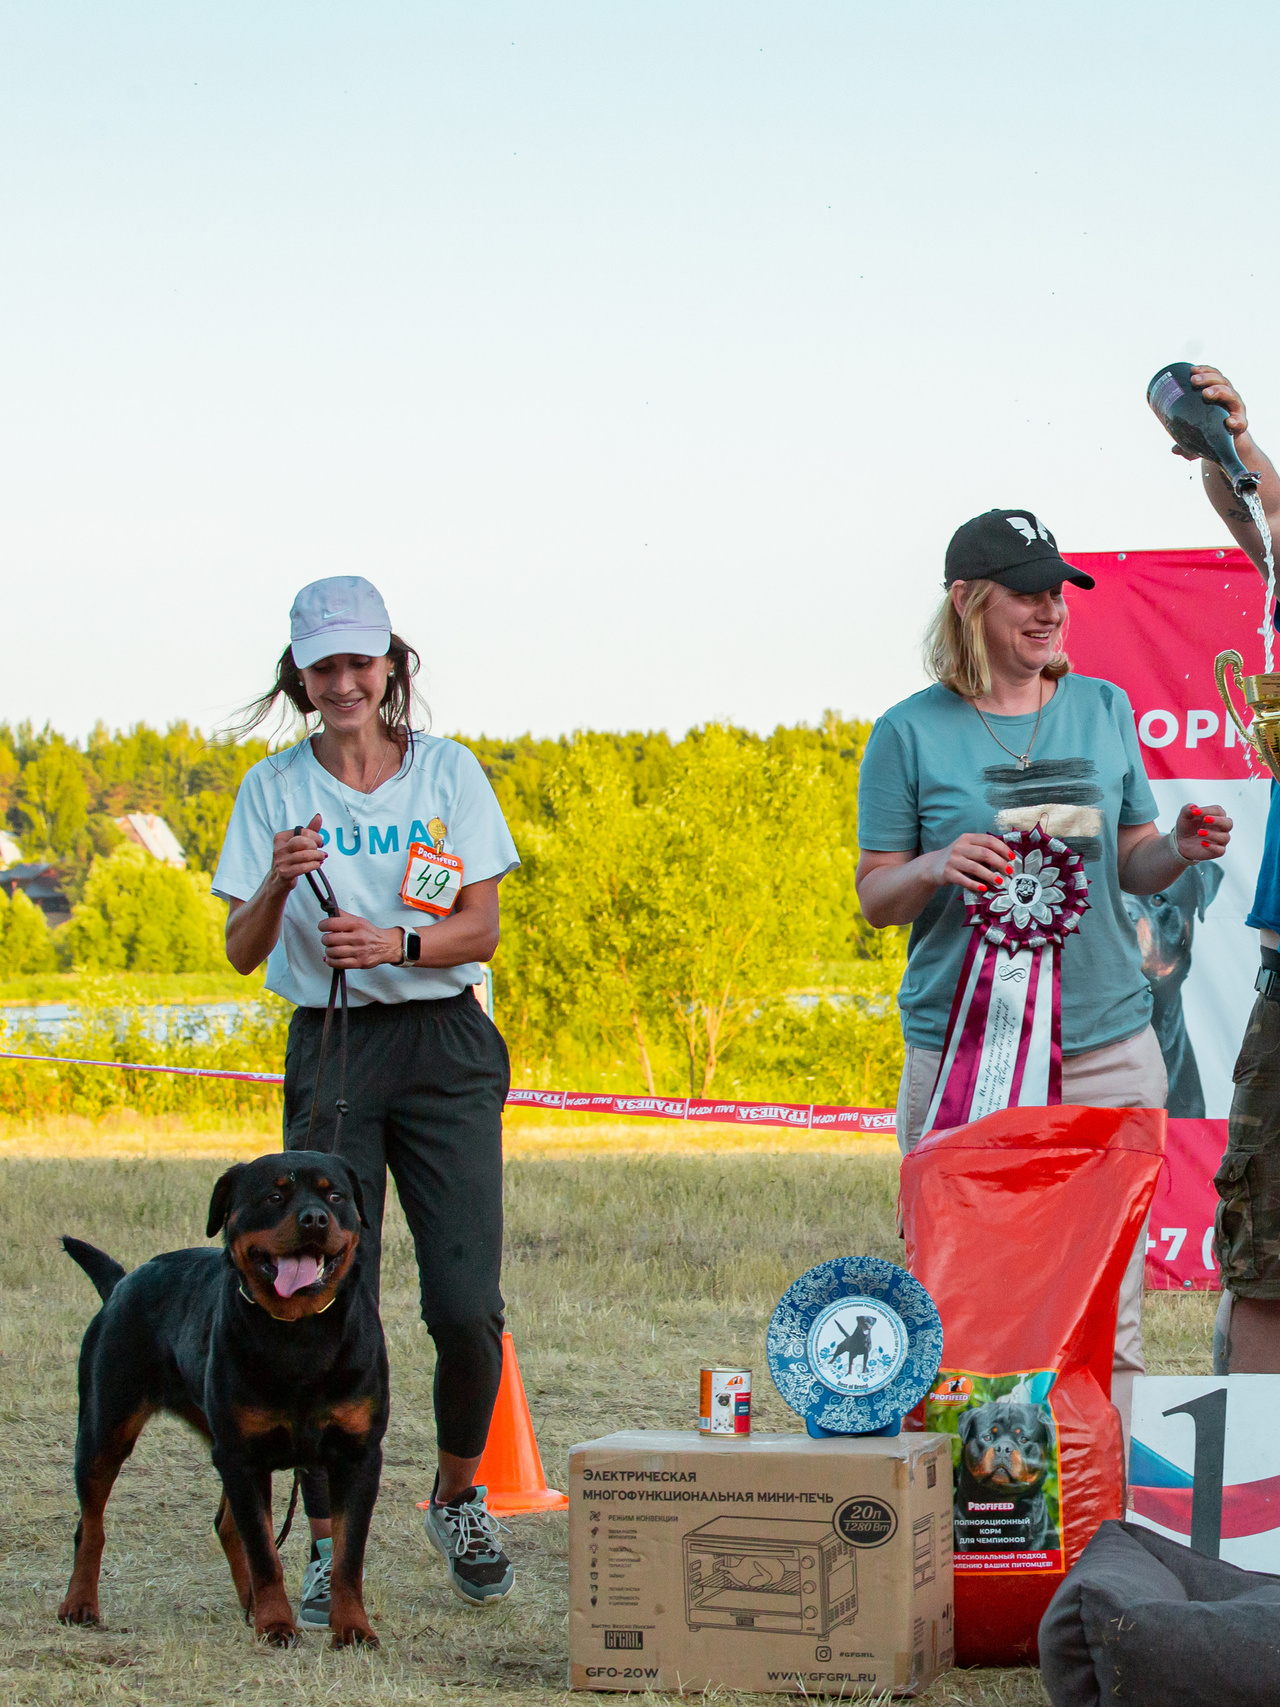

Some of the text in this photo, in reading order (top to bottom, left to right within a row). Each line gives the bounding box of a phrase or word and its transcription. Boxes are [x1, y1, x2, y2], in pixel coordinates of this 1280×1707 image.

[416, 864, 450, 899] 49
[616, 1098, 684, 1114] ТРАПЕЗА
[738, 1107, 808, 1123] ТРАПЕЗА
[929, 1392, 969, 1401] PROFIFEED
[583, 1469, 697, 1483] ЭЛЕКТРИЧЕСКАЯ
[1162, 1388, 1227, 1559] 1
[583, 1489, 834, 1504] МНОГОФУНКЦИОНАЛЬНАЯ МИНИ-ПЕЧЬ
[968, 1502, 1014, 1511] PROFIFEED
[844, 1522, 872, 1532] 1280
[954, 1517, 1030, 1526] ПОЛНОРАЦИОННЫЙ
[1017, 1552, 1047, 1560] ПОДХОД
[585, 1667, 659, 1678] GFO-20W
[767, 1671, 878, 1682] WWW.GFGRIL.RU
